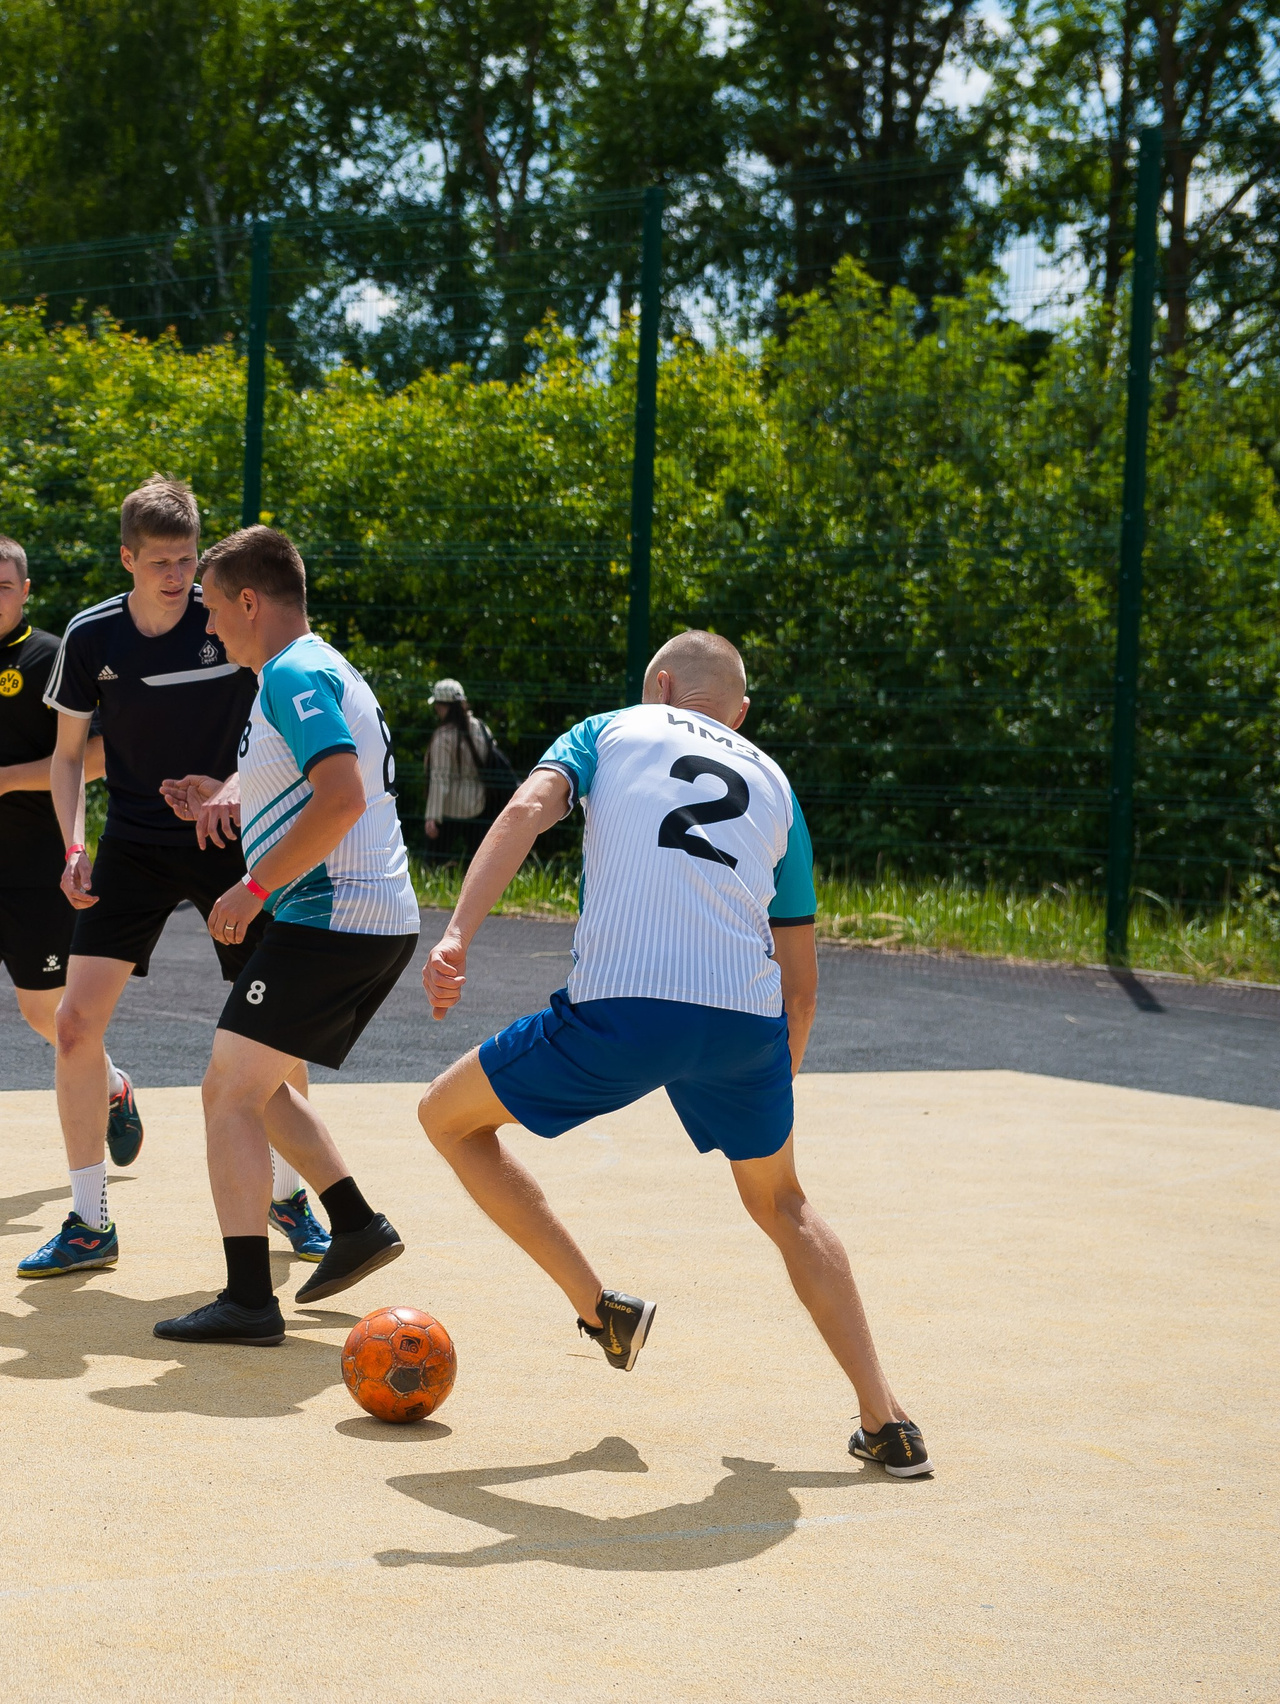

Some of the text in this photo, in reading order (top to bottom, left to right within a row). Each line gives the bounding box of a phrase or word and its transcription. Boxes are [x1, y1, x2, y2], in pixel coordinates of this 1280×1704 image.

[0, 673, 19, 689] BVB
[239, 720, 252, 758] 8
[658, 754, 750, 870] 2
[246, 980, 266, 1005] 8
[604, 1300, 634, 1314] TIEMPO
[897, 1427, 912, 1460] TIEMPO
